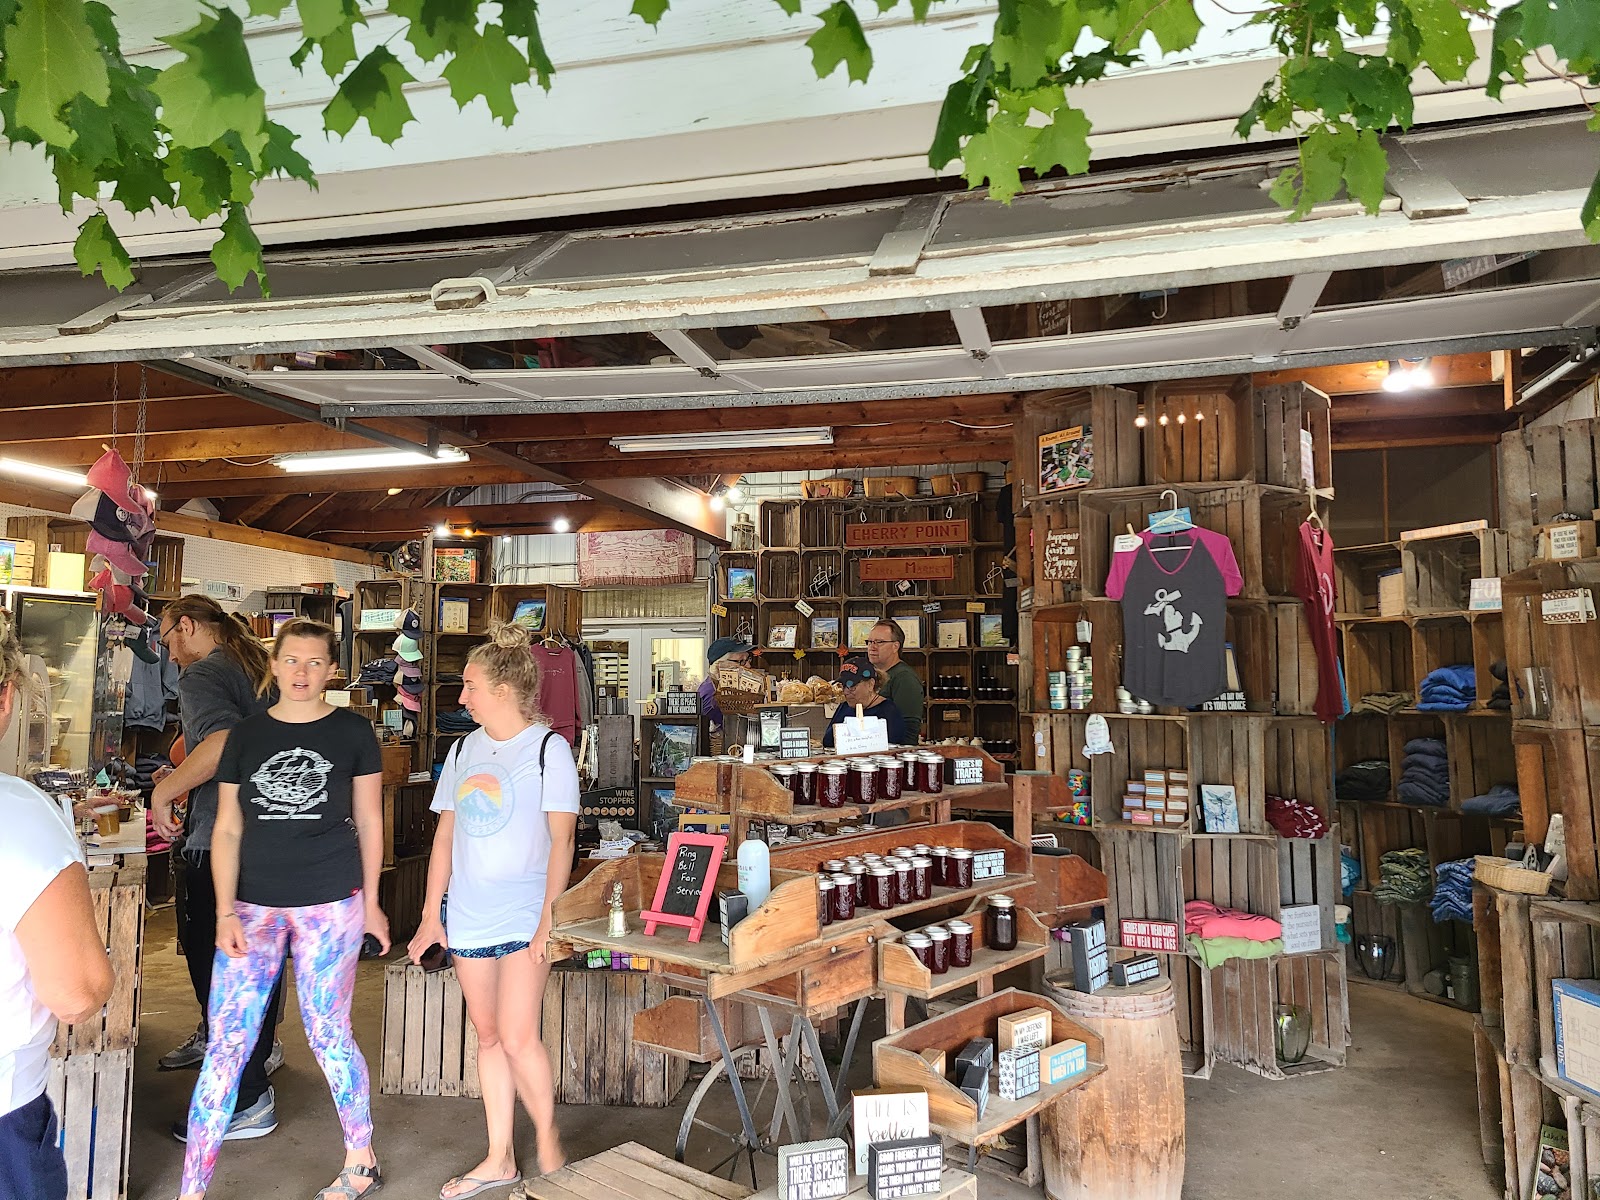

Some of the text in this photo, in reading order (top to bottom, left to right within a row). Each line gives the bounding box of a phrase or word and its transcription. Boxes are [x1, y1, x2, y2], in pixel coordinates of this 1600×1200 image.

[853, 524, 960, 540] CHERRY POINT
[1213, 701, 1227, 710] YOUR
[1228, 701, 1246, 710] CHOICE
[782, 748, 808, 757] BEST FRIEND
[955, 759, 982, 768] THERE'S NO
[956, 768, 982, 779] TRAFFIC
[600, 797, 635, 805] STOPPERS
[679, 846, 697, 861] Ring
[678, 860, 695, 871] Bell
[681, 872, 696, 882] For
[1123, 922, 1176, 937] HEROES DON'T WEAR CAPES
[1123, 935, 1176, 950] THEY WEAR DOG TAGS
[1291, 941, 1300, 949] soul
[1026, 1022, 1042, 1032] DEFENSE
[1021, 1036, 1029, 1044] WAS
[1030, 1032, 1039, 1041] LEFT
[1557, 1044, 1565, 1065] 500
[903, 1097, 917, 1116] IS
[789, 1154, 803, 1166] WHEN
[803, 1153, 812, 1165] THE
[812, 1152, 826, 1164] QUEEN
[879, 1145, 941, 1163] GOOD FRIENDS ARE LIKE
[789, 1159, 846, 1185] THERE IS PEACE
[879, 1157, 941, 1176] STARS YOU DON'T ALWAYS
[879, 1169, 941, 1188] SEE THEM BUT YOU KNOW
[789, 1176, 846, 1200] IN THE KINGDOM
[879, 1181, 941, 1200] THEY'RE ALWAYS THERE
